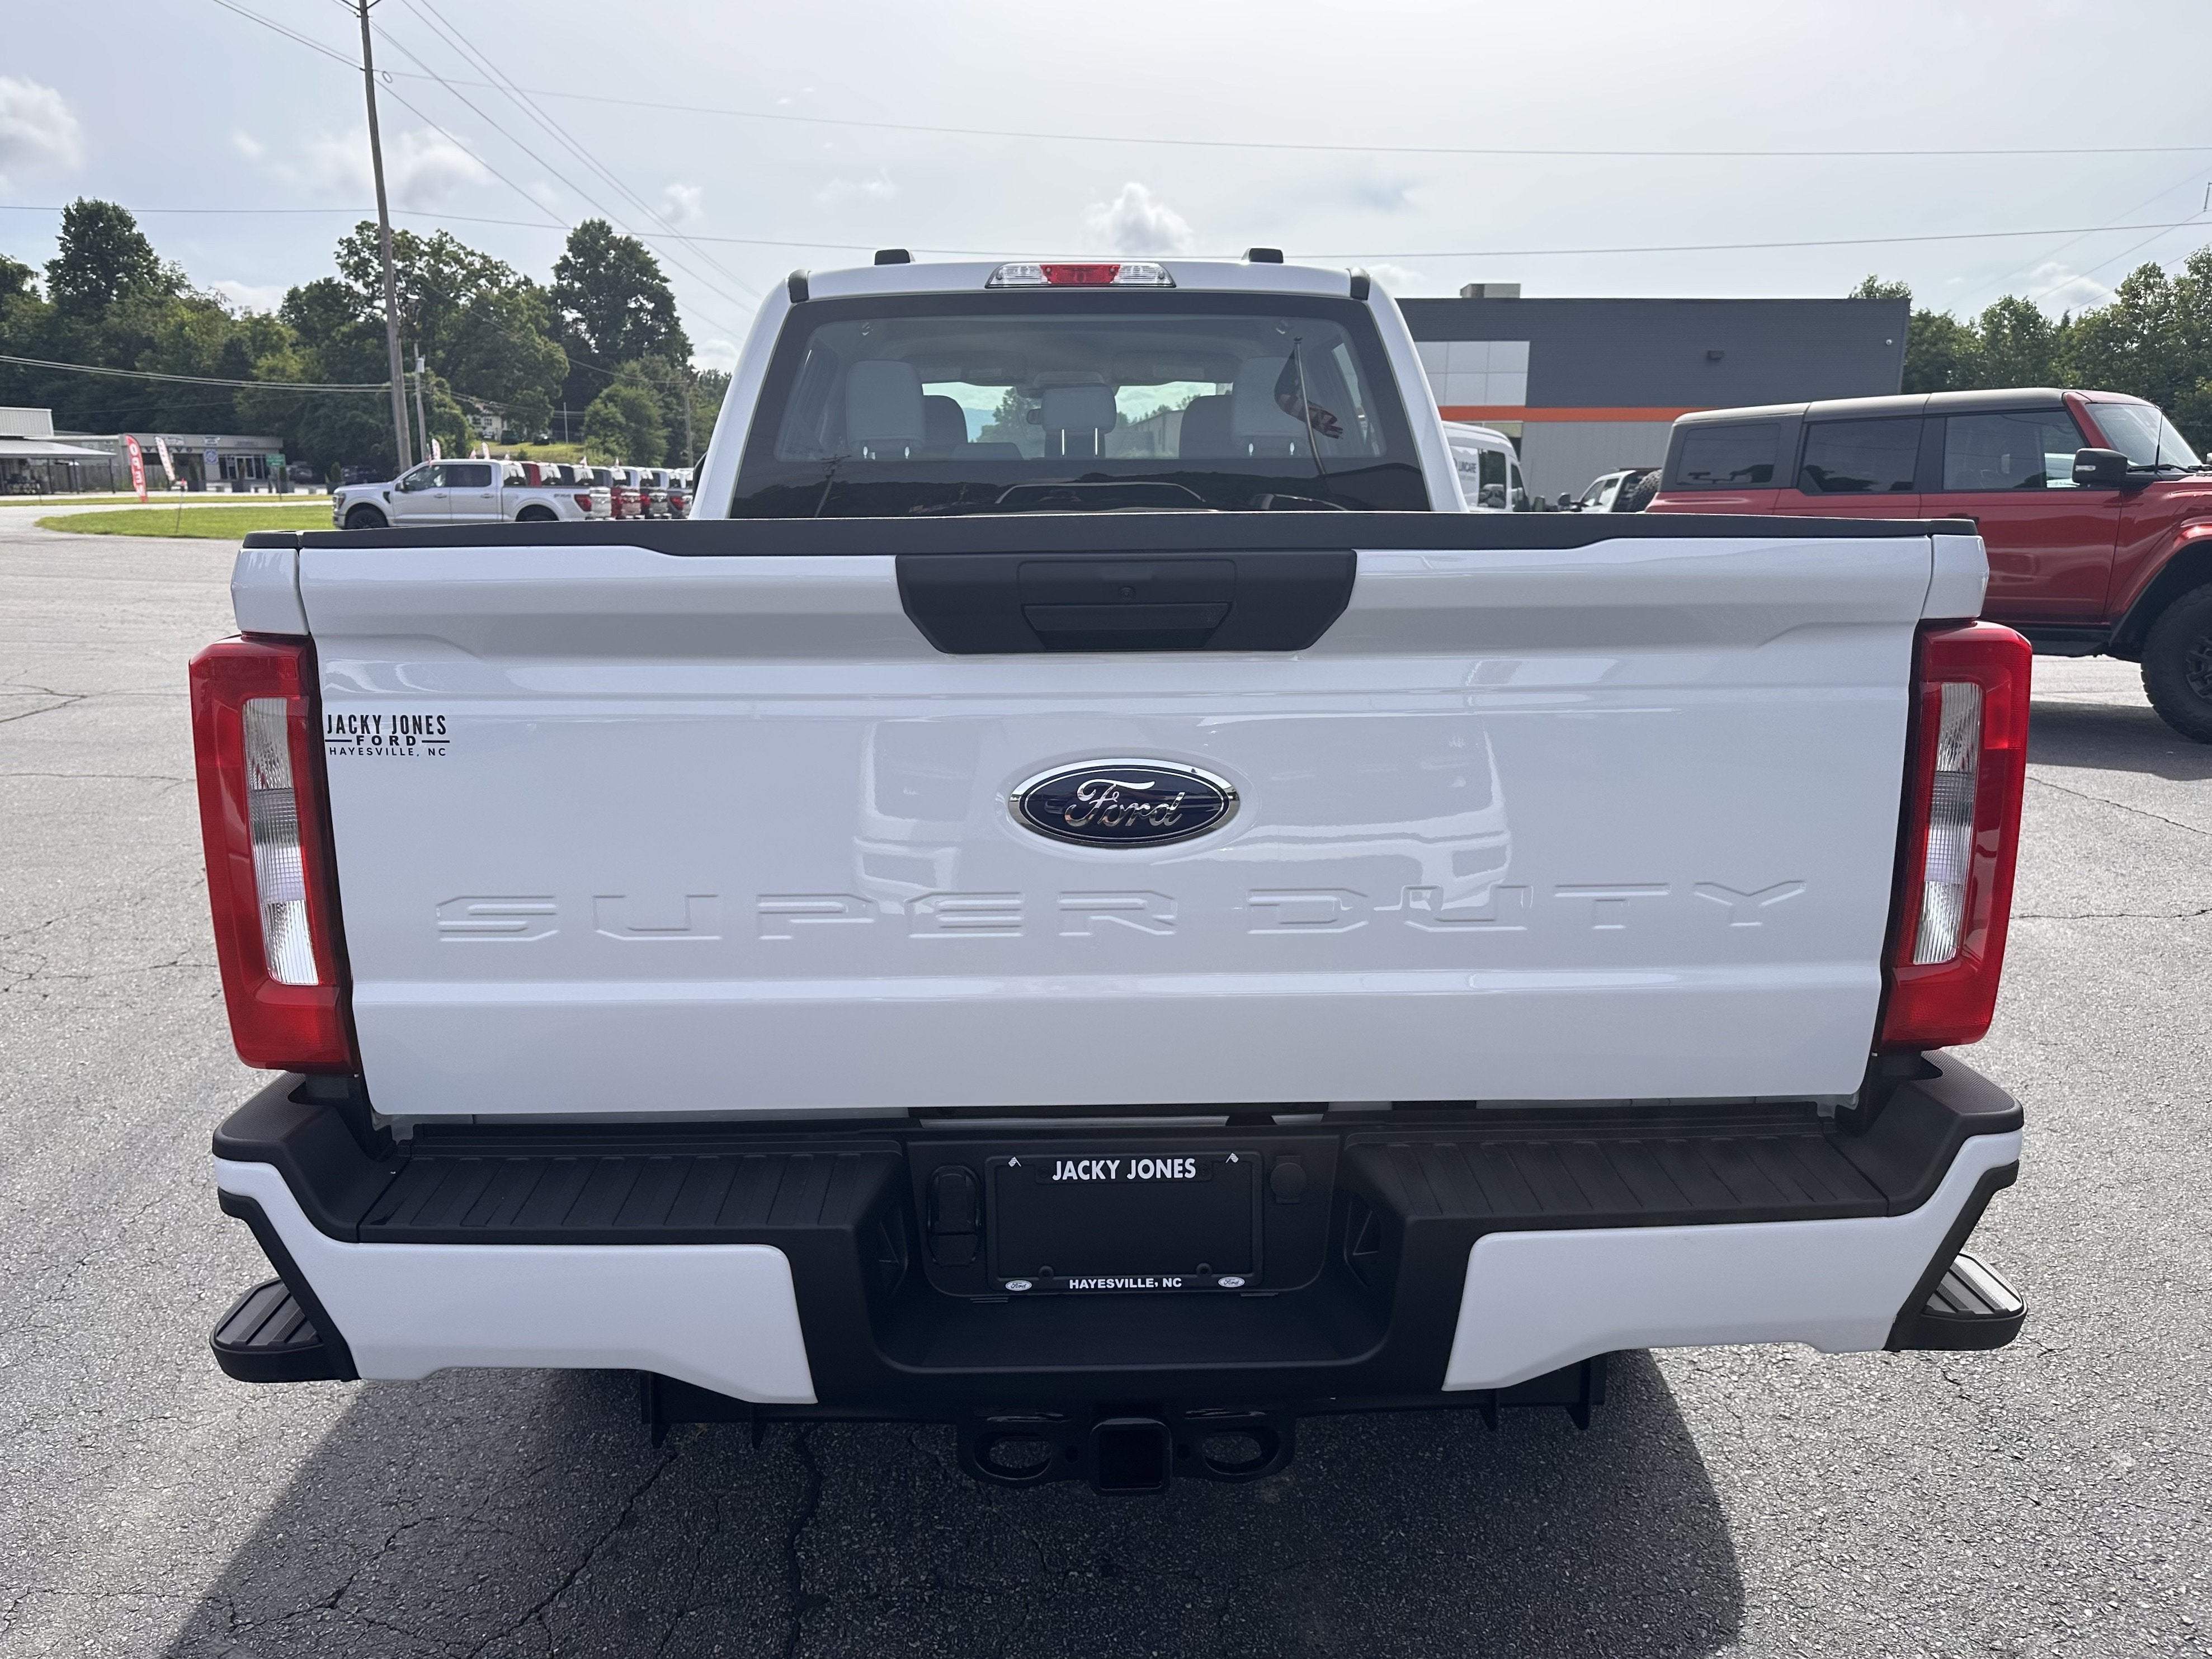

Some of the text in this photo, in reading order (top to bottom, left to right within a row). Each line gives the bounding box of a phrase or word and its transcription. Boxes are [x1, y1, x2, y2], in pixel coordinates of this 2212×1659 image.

[327, 714, 446, 735] JACKY JONES
[356, 735, 416, 746] FORD
[329, 747, 446, 757] HAYESVILLE, NC
[1064, 779, 1186, 827] Ford
[436, 880, 1807, 942] SUPER DUTY
[1052, 1158, 1196, 1181] JACKY JONES
[1069, 1278, 1182, 1289] HAYESVILLE, NC
